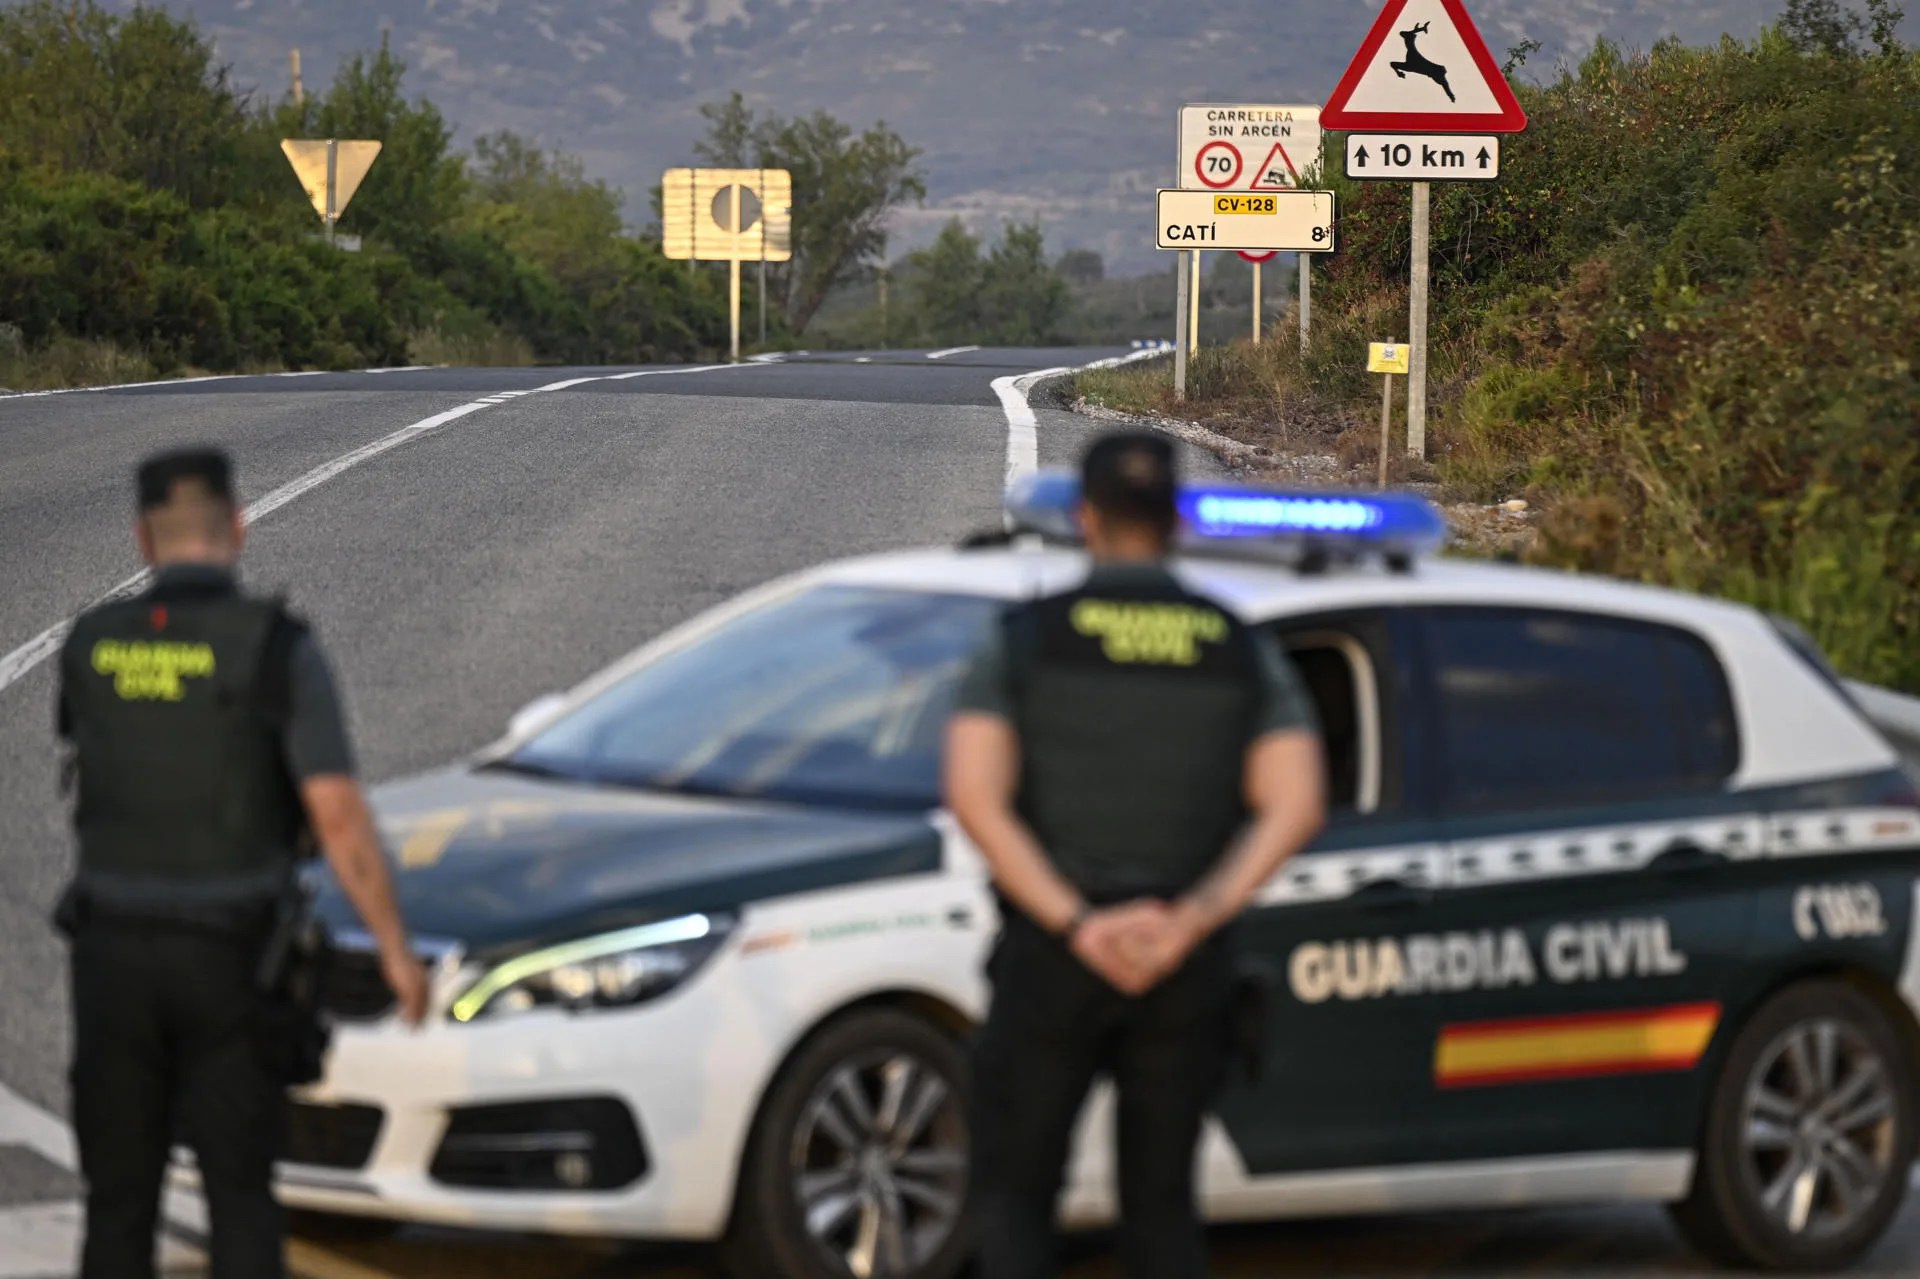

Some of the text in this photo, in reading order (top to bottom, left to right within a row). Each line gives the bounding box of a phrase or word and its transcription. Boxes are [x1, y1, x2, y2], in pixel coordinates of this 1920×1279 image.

[1207, 110, 1294, 122] CARRETERA
[1208, 124, 1292, 137] SIN ARCÉN
[1380, 143, 1465, 167] 10 km
[1206, 157, 1232, 173] 70
[1217, 198, 1274, 212] CV-128
[1166, 222, 1325, 243] CATÍ 8
[1288, 916, 1688, 1003] GUARDIA CIVIL
